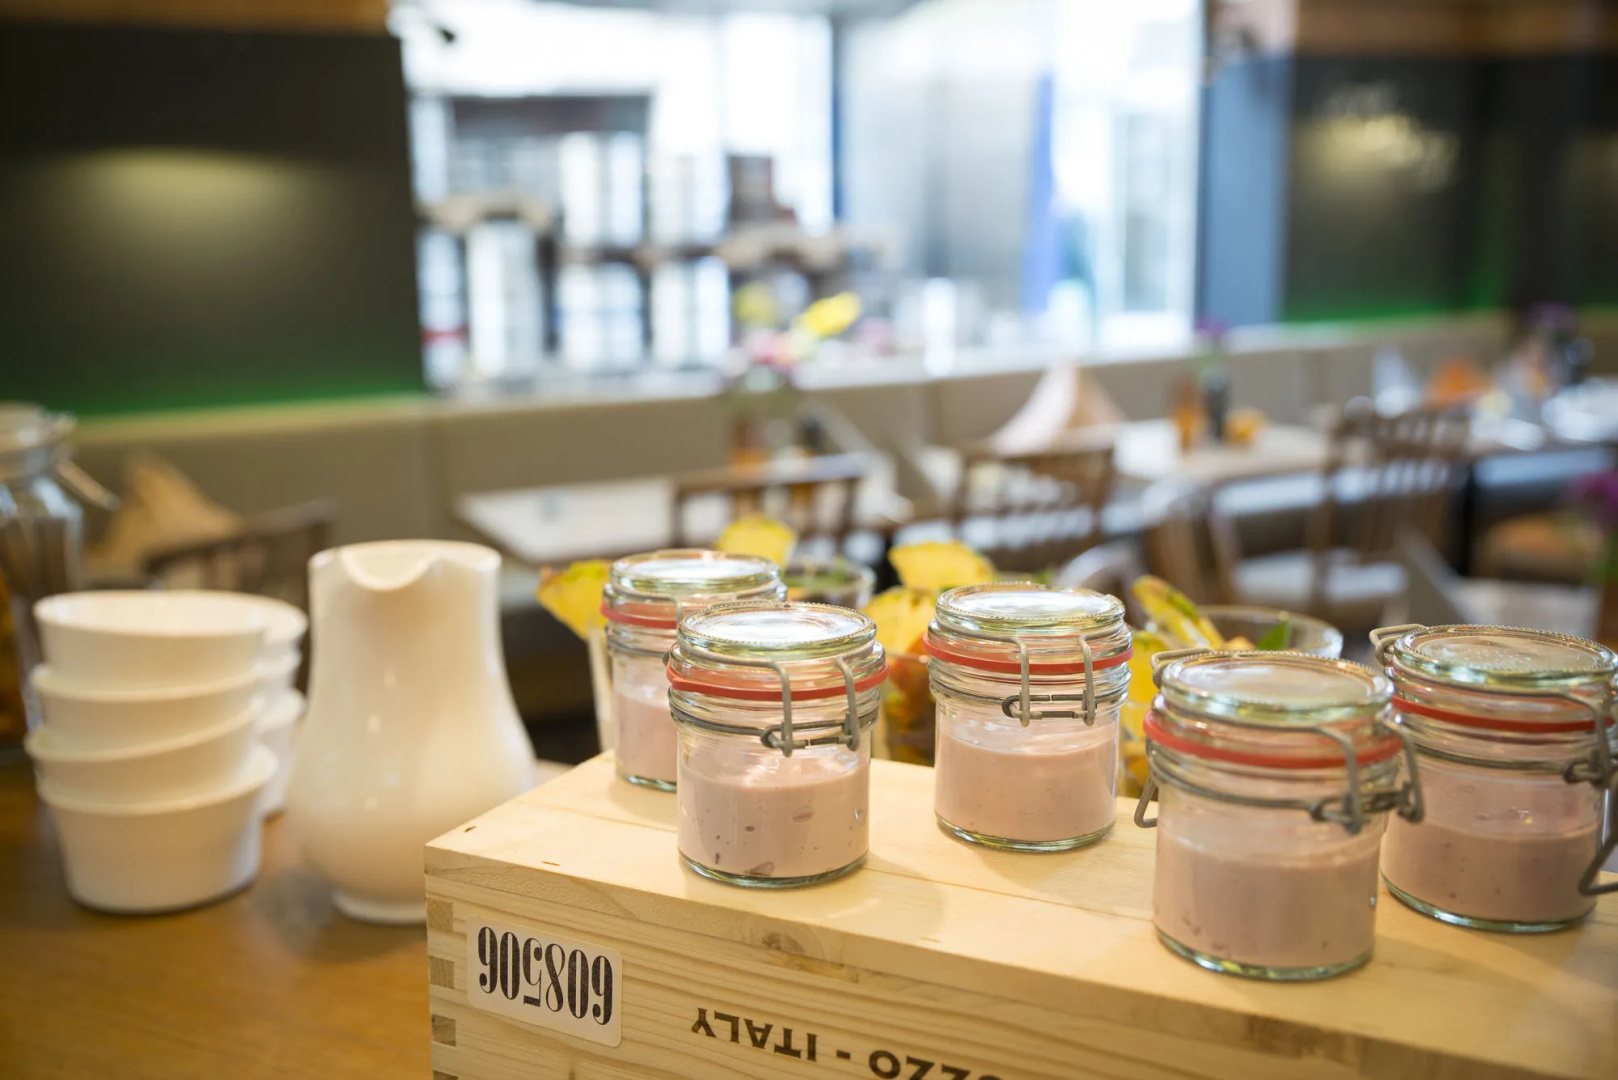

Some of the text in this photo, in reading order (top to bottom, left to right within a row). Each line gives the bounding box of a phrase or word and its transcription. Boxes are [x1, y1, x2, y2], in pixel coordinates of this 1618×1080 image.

[478, 926, 613, 1025] 608506
[691, 1008, 817, 1062] ITALY
[868, 1050, 1004, 1080] ZZO
